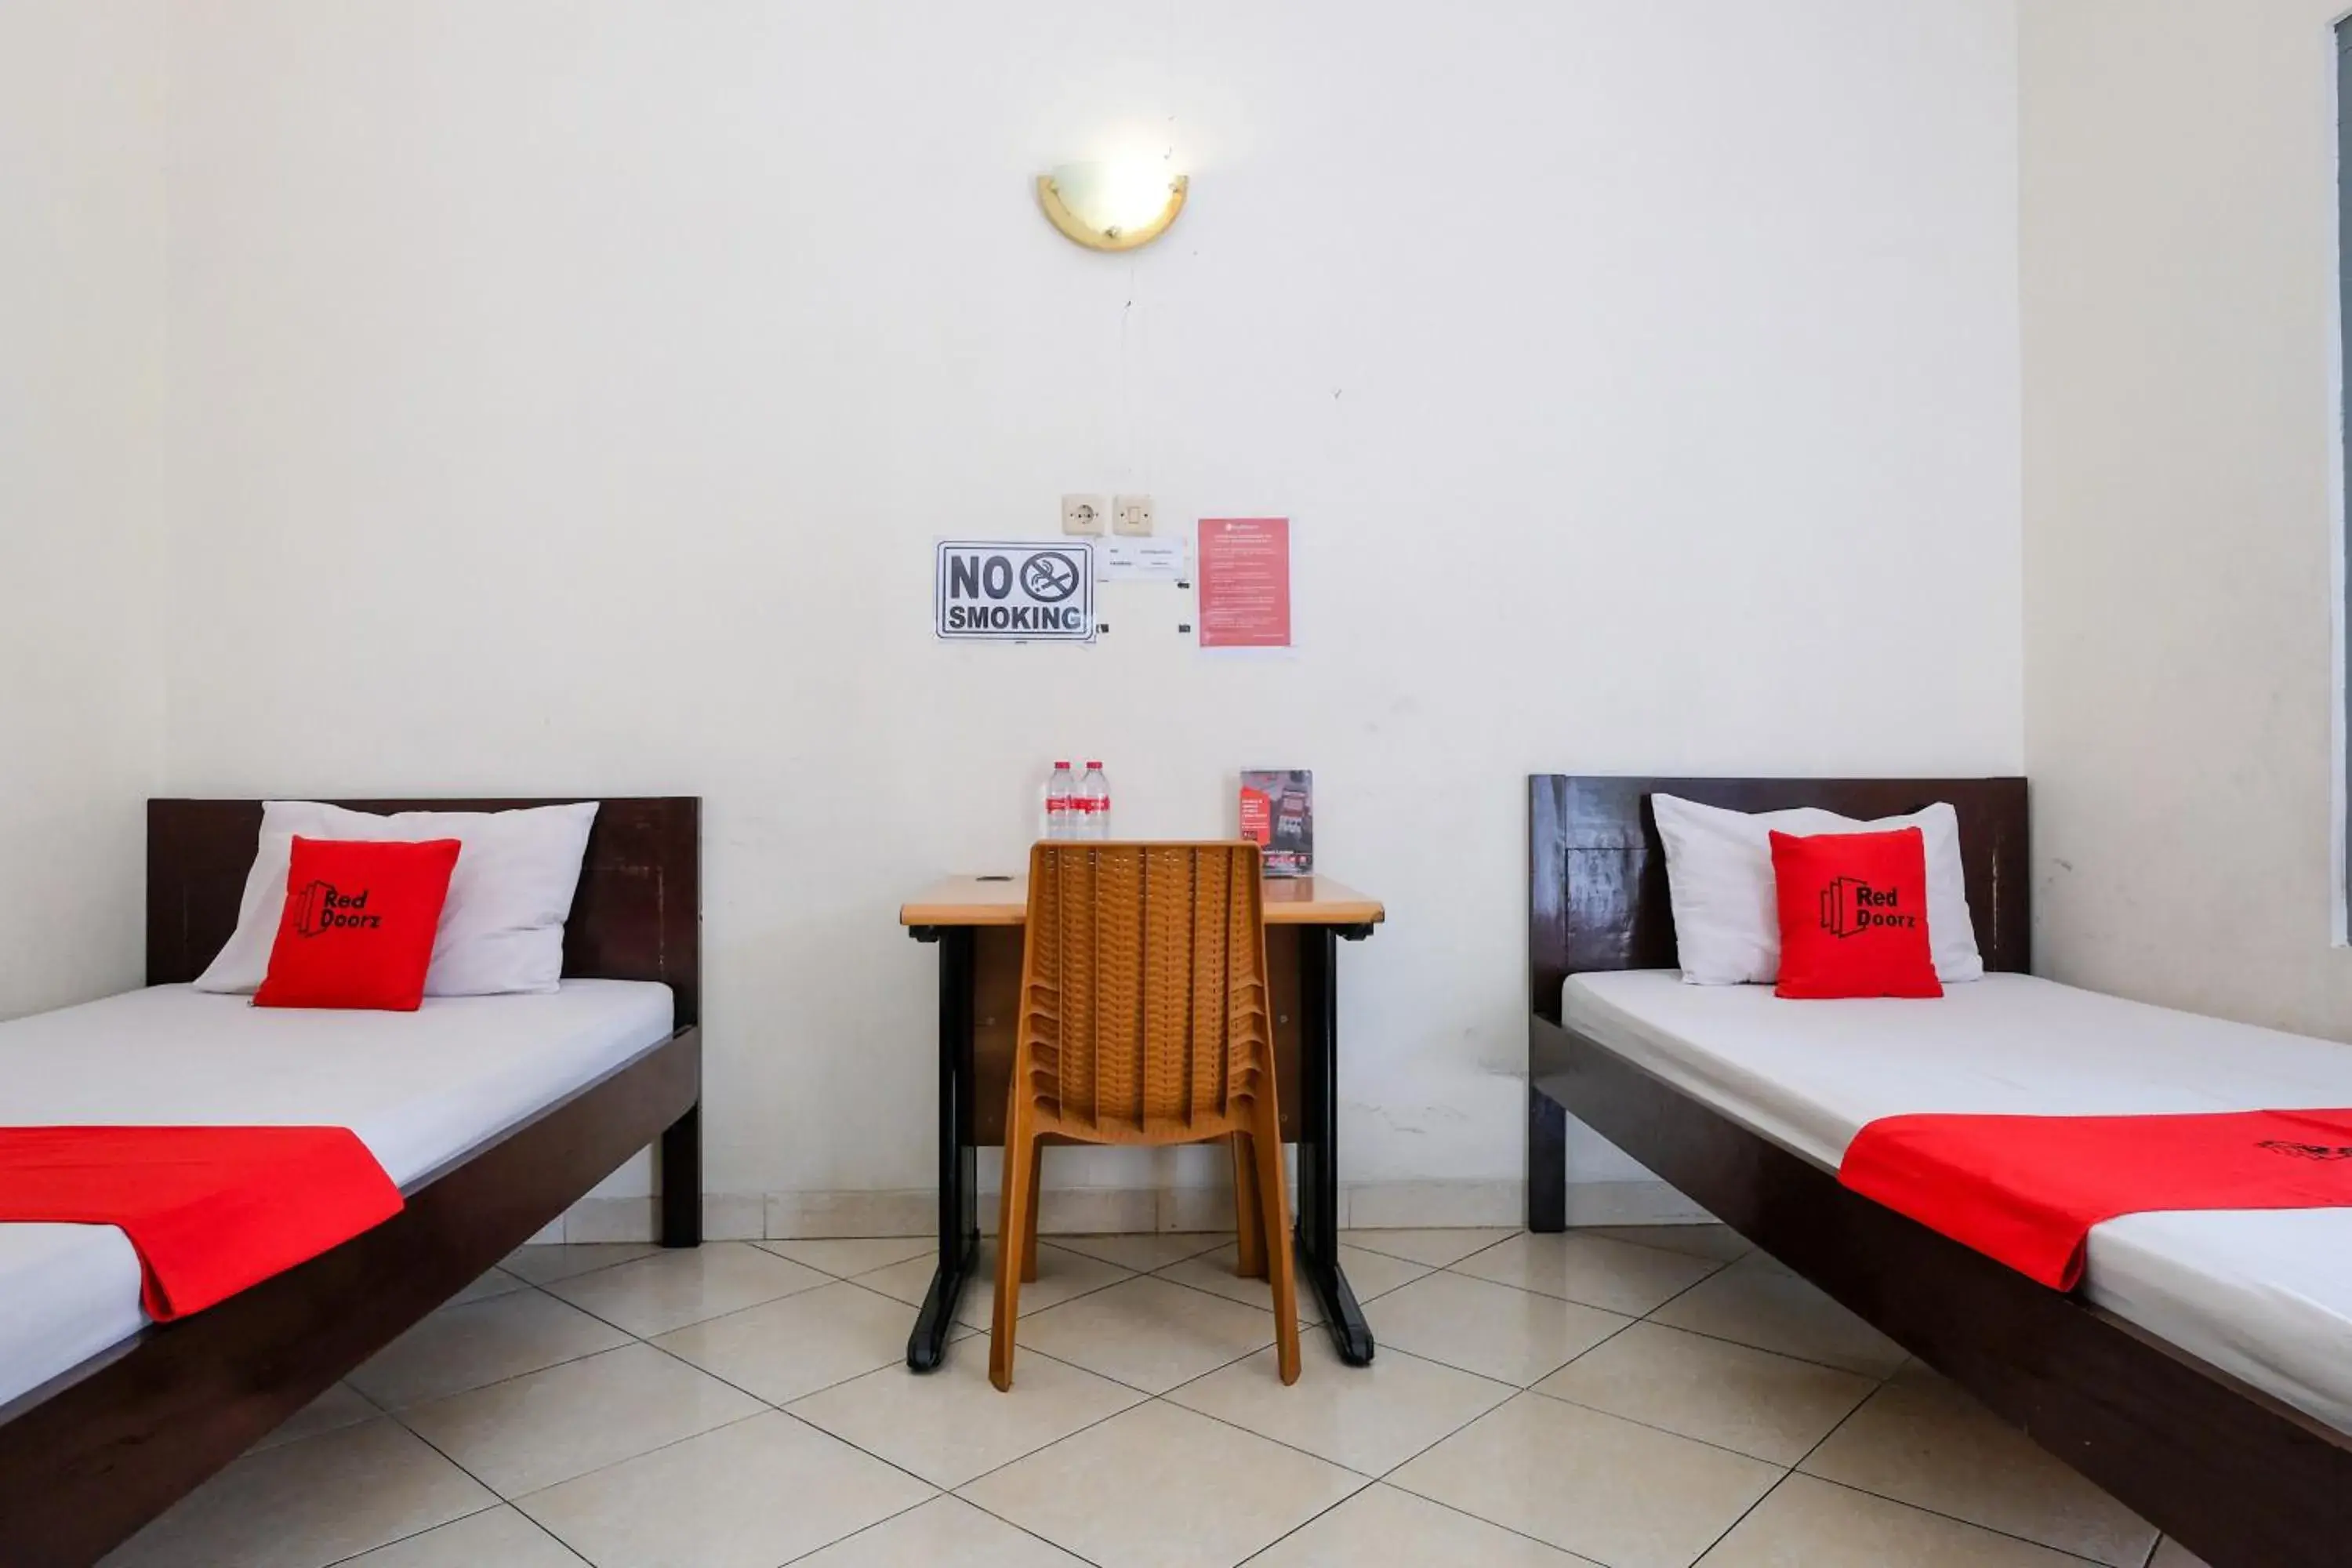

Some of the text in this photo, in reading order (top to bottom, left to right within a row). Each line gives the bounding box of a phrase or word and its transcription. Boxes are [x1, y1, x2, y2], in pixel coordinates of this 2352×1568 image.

[950, 555, 1013, 599] NO
[949, 606, 1080, 629] SMOKING
[324, 889, 368, 909] Red
[1856, 886, 1898, 907] Red
[319, 909, 382, 929] Doorz
[1856, 909, 1916, 928] Doorz
